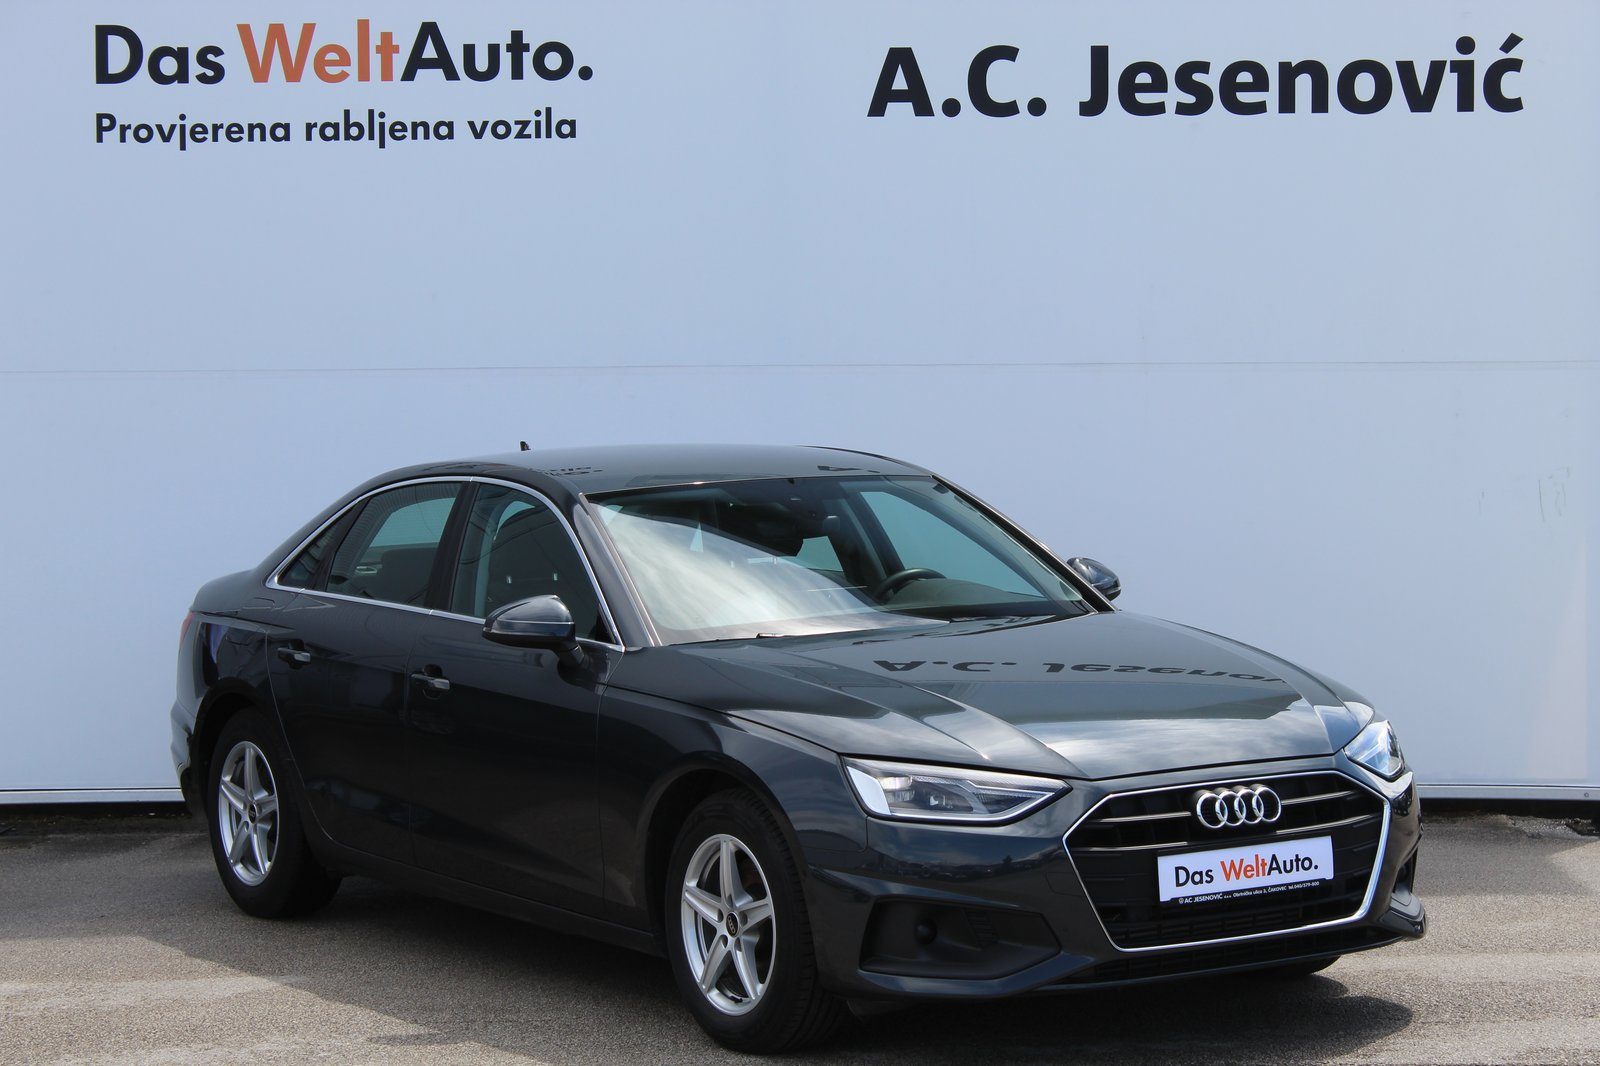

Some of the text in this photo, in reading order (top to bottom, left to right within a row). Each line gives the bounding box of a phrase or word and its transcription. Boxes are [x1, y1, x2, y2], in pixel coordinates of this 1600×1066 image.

[95, 19, 593, 85] Das WeltAuto.
[867, 33, 1523, 117] A.C. Jesenović
[96, 107, 576, 151] Provjerena rabljena vozila
[1175, 854, 1319, 887] Das WeltAuto.
